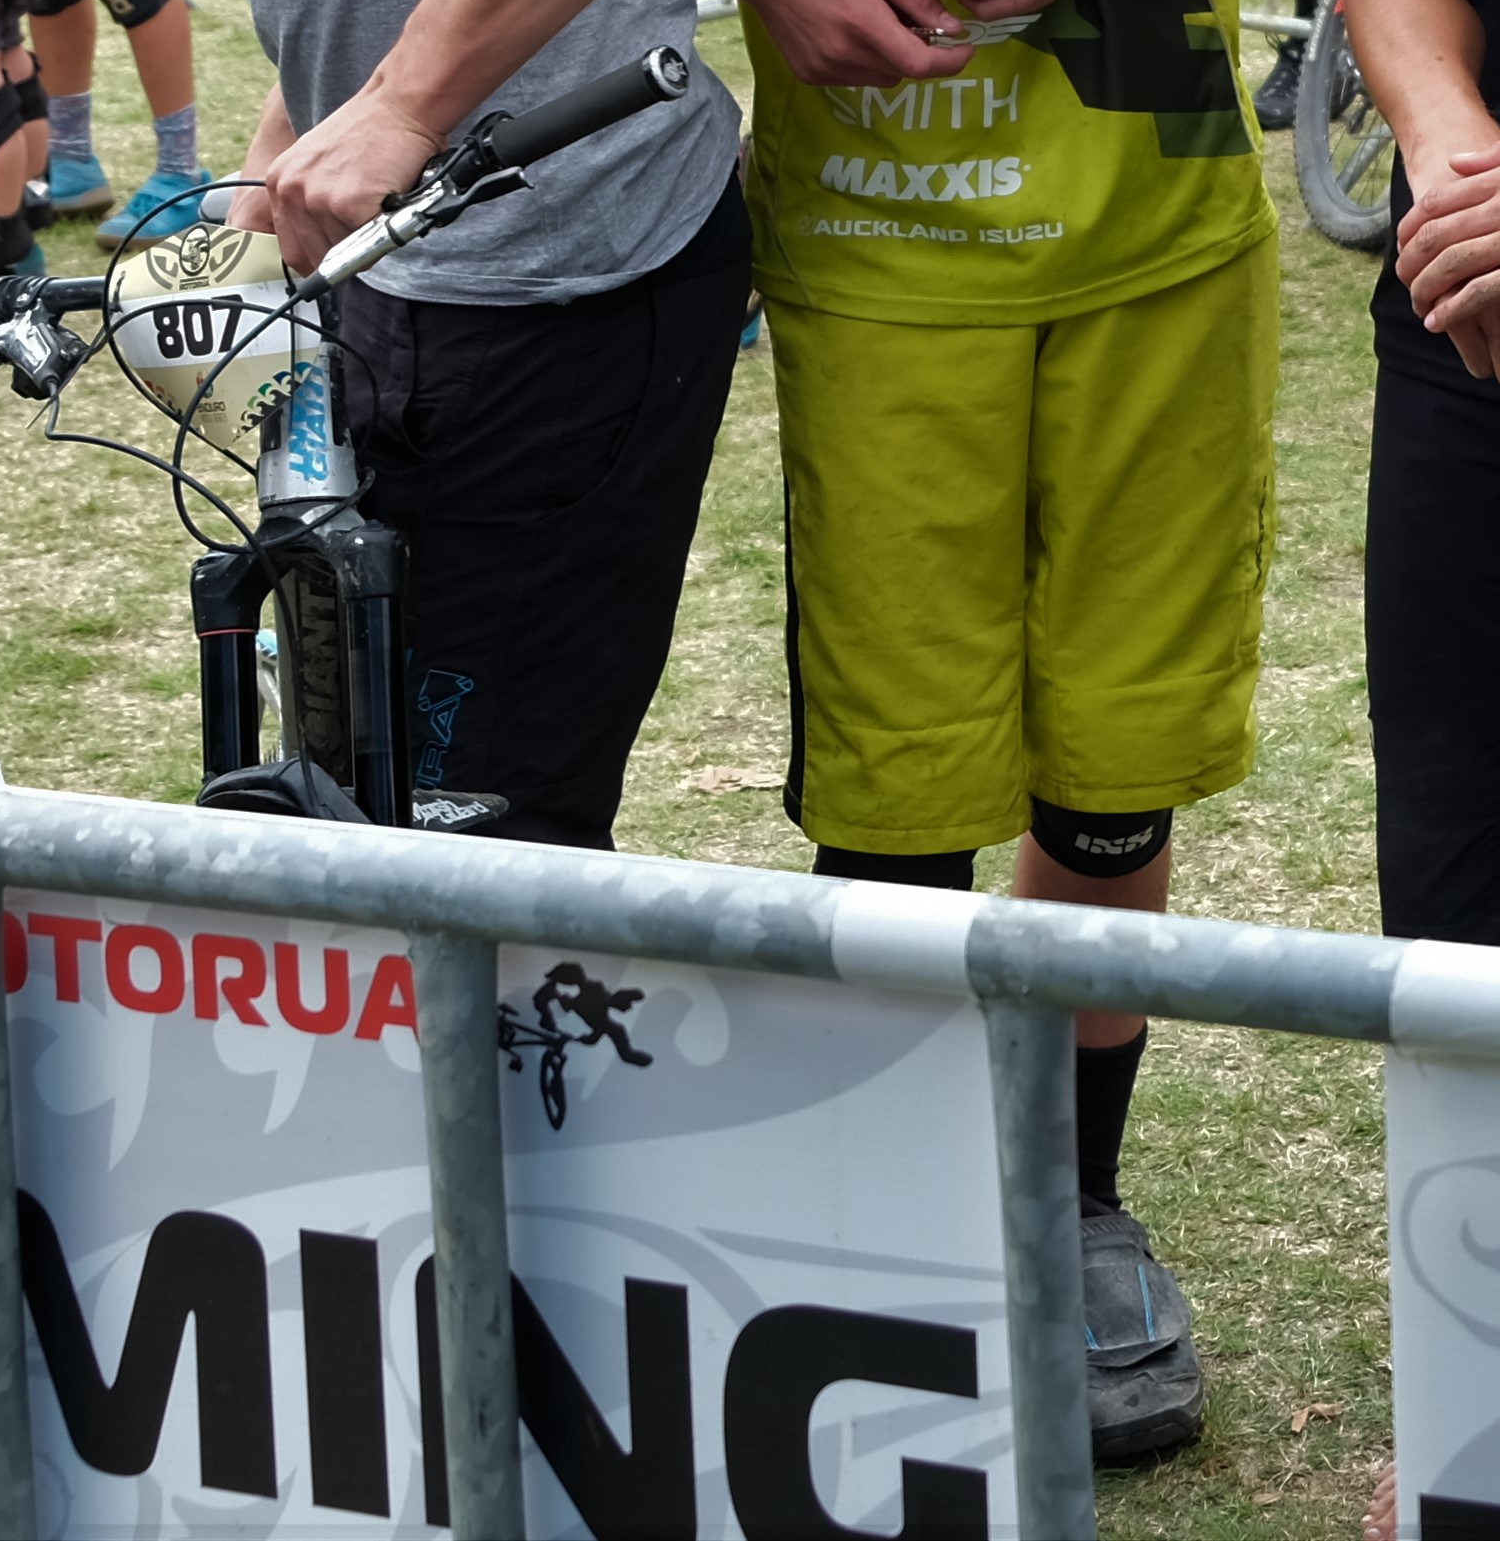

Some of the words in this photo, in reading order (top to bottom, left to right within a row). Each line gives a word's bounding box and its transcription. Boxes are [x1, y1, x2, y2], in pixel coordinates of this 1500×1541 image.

[823, 74, 1020, 130] SMITH
[820, 155, 1024, 202] MAXXIS
[813, 219, 968, 243] AUCKLAND
[979, 221, 1064, 245] ISUZU
[153, 293, 244, 360] 807
